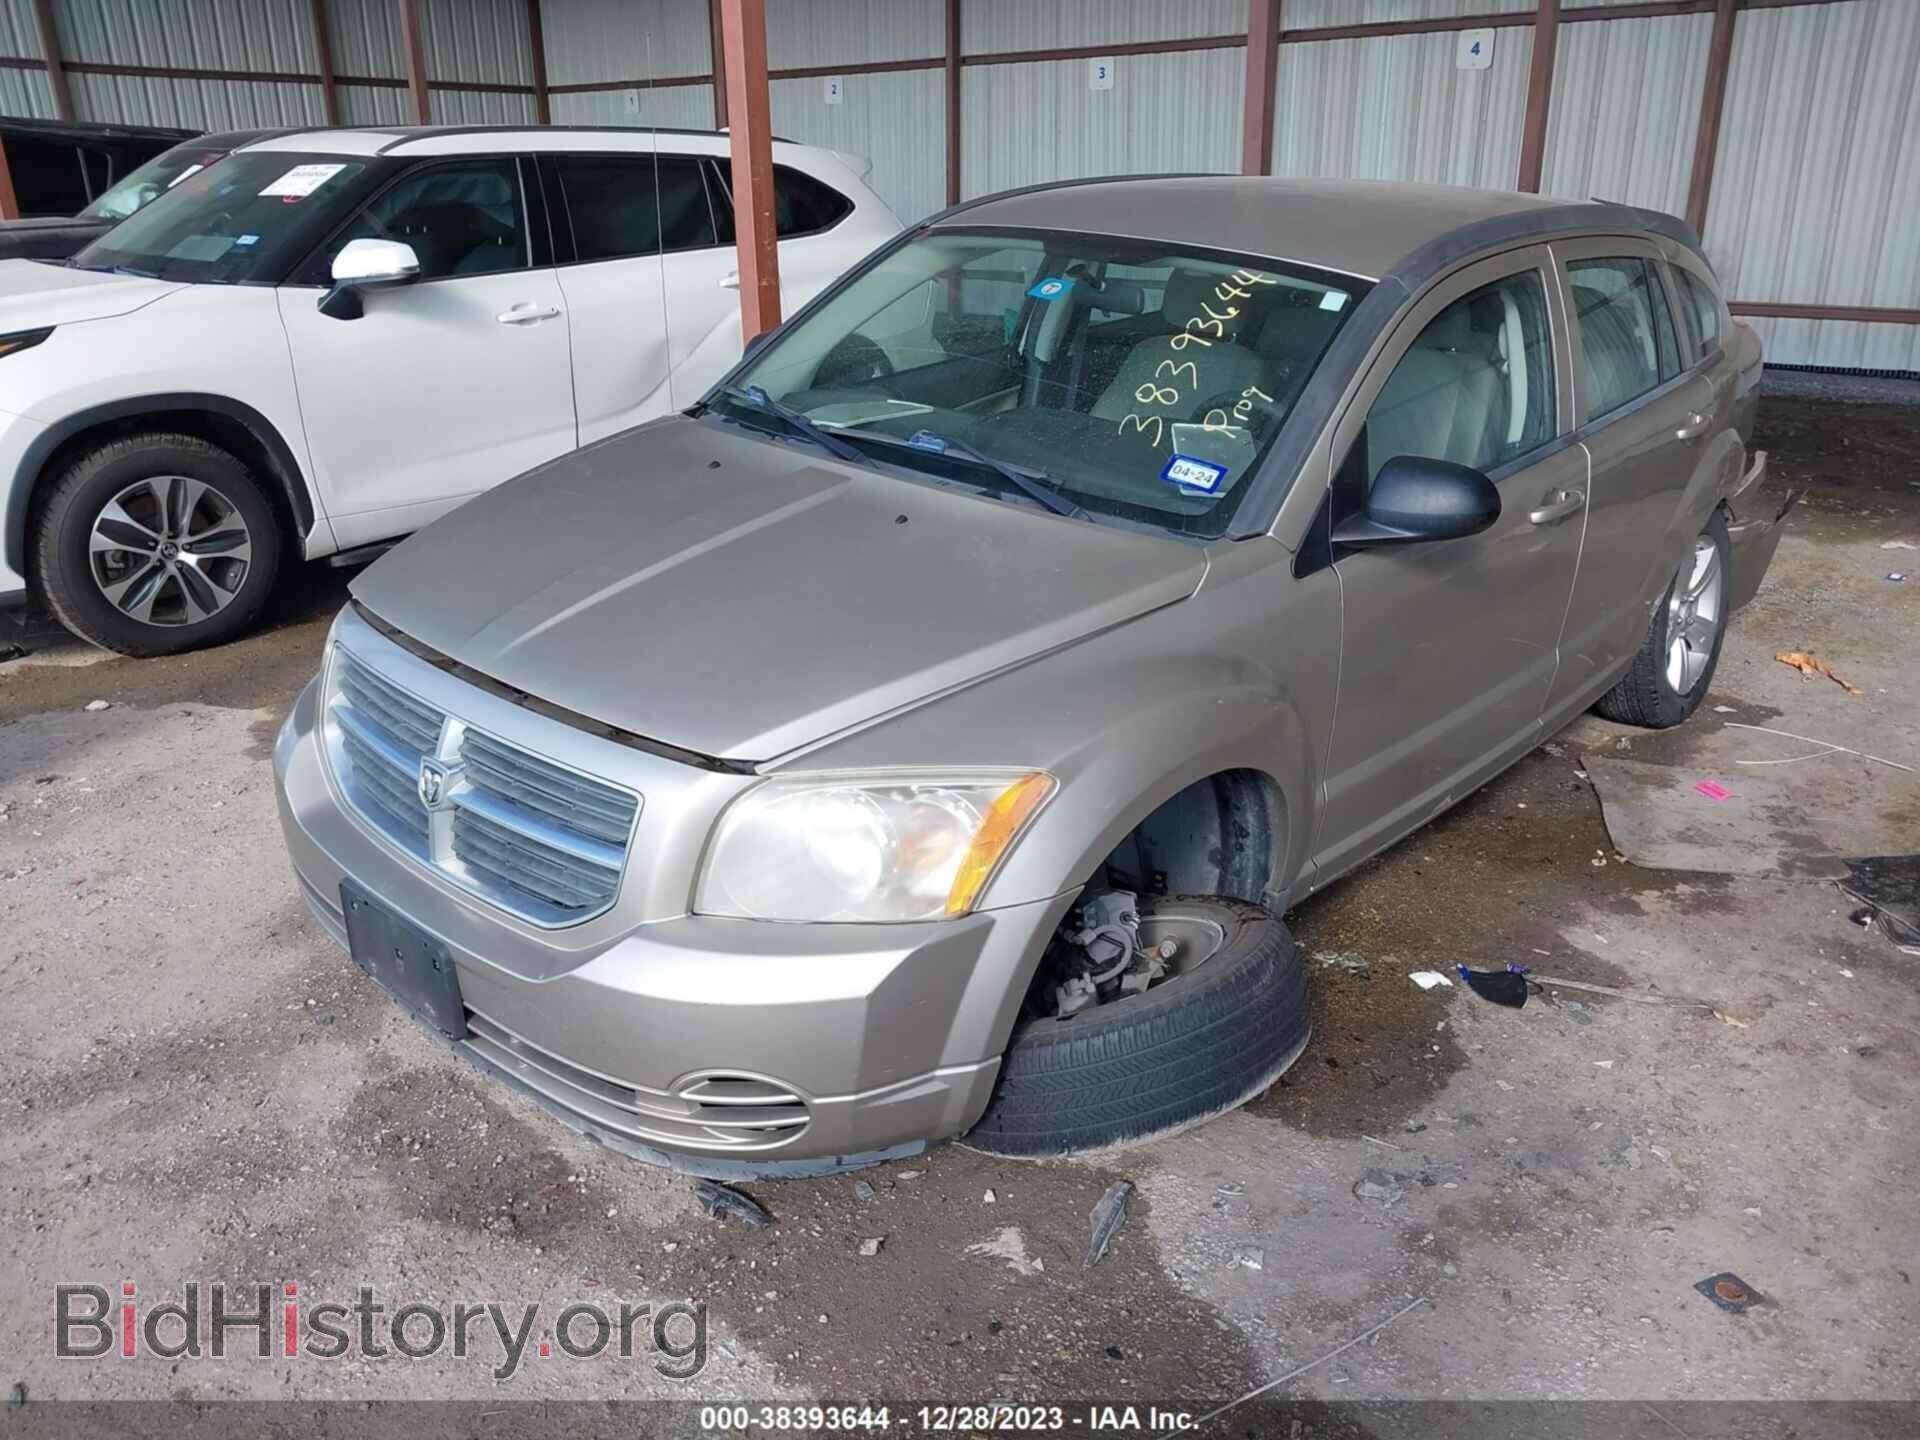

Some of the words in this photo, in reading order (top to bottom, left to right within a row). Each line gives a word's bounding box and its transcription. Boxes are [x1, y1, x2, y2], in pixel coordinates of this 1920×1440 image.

[1470, 41, 1481, 56] 4
[1098, 66, 1106, 79] 3
[831, 84, 837, 95] 2
[1172, 464, 1214, 484] 04-24
